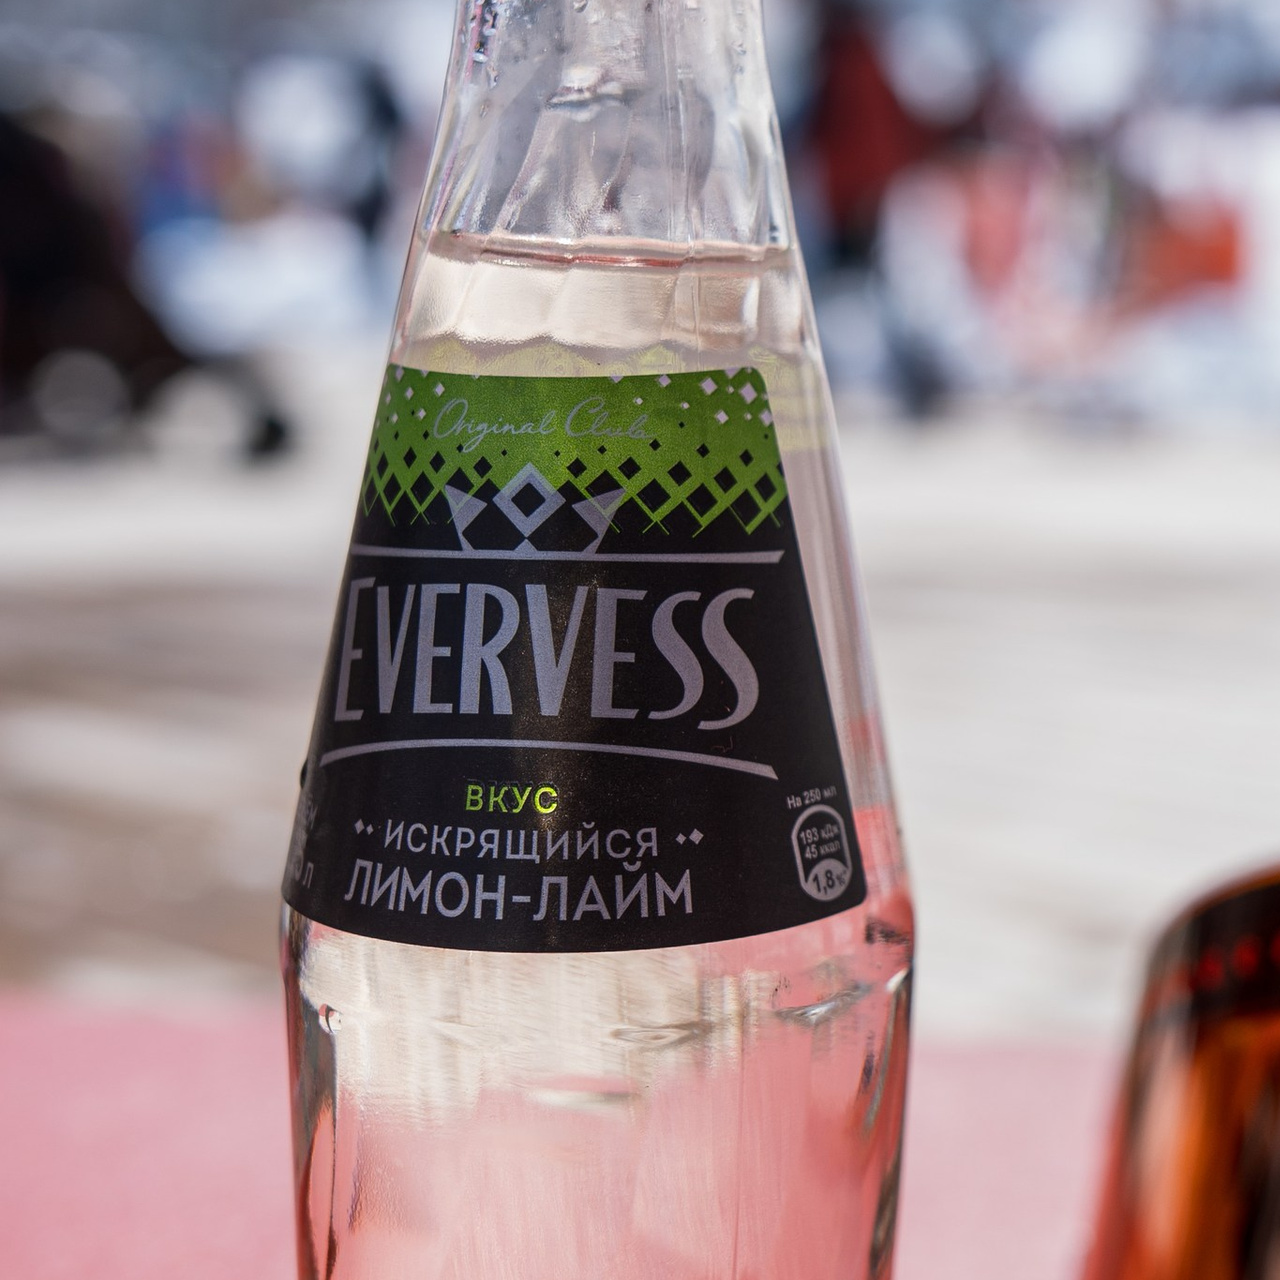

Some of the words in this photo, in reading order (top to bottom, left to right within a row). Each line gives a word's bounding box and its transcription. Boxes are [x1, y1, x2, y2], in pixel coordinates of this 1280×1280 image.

[433, 398, 555, 453] Original
[565, 396, 657, 439] Club
[334, 577, 760, 731] EVERVESS
[465, 783, 559, 815] ВКУС
[787, 795, 802, 809] На
[803, 788, 821, 805] 250
[384, 819, 659, 864] ИСКРЯЩИЙСЯ
[800, 827, 819, 844] 193
[805, 844, 818, 859] 45
[344, 858, 693, 921] ЛИМОН-ЛАЙМ
